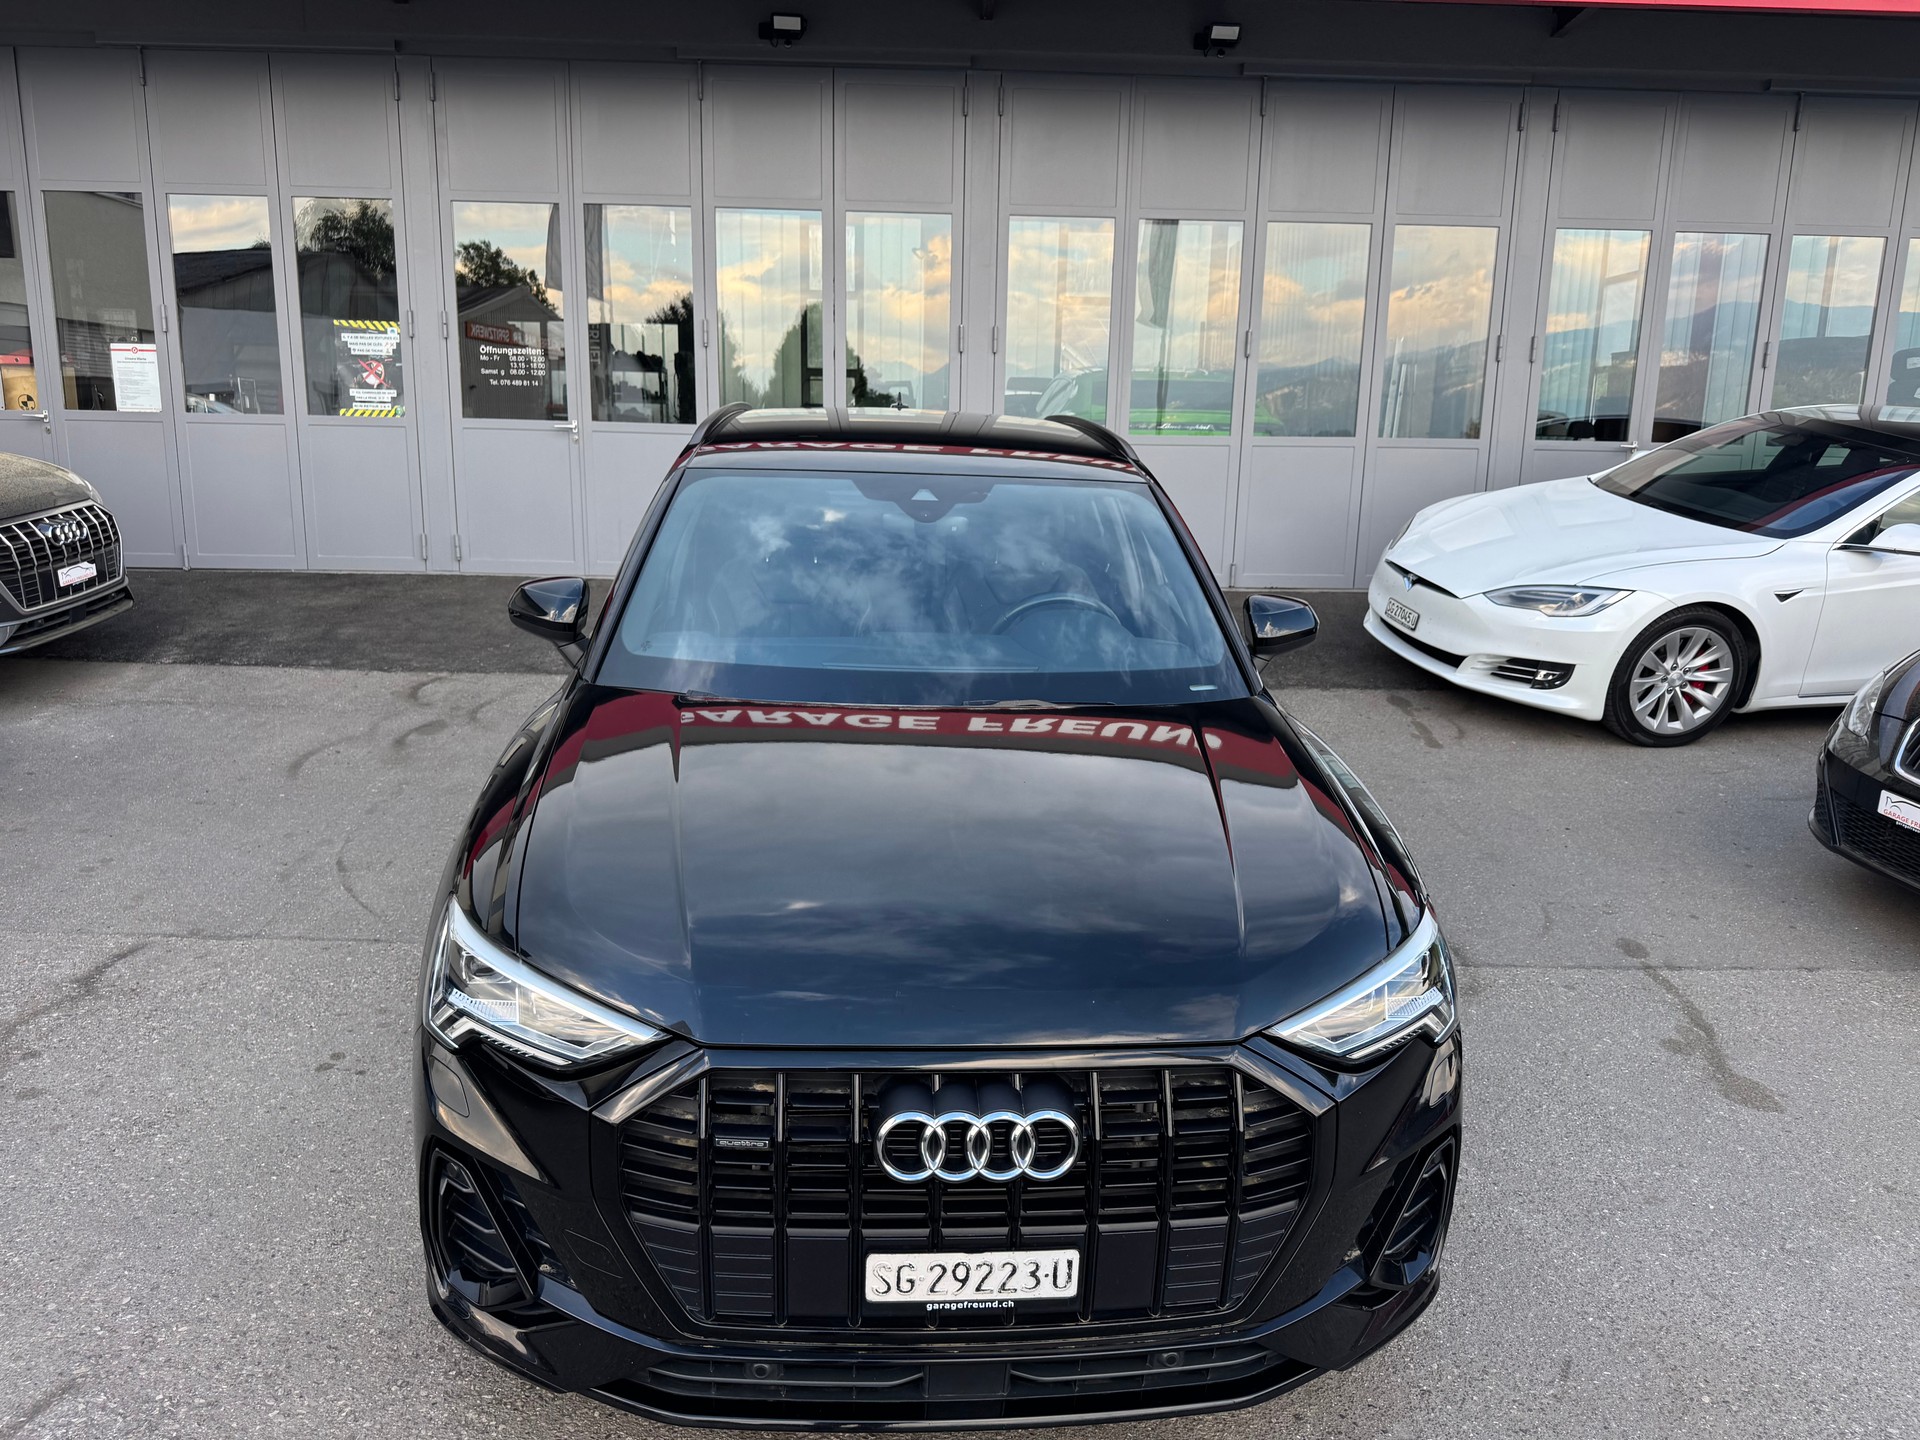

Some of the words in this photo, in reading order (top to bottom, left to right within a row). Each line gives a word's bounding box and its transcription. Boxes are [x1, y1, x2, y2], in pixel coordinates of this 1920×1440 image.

[480, 344, 545, 356] Öffnungszeiten:
[480, 368, 505, 376] Samstg
[1883, 808, 1910, 823] GARAGE
[926, 1301, 1015, 1311] garagefreund.ch
